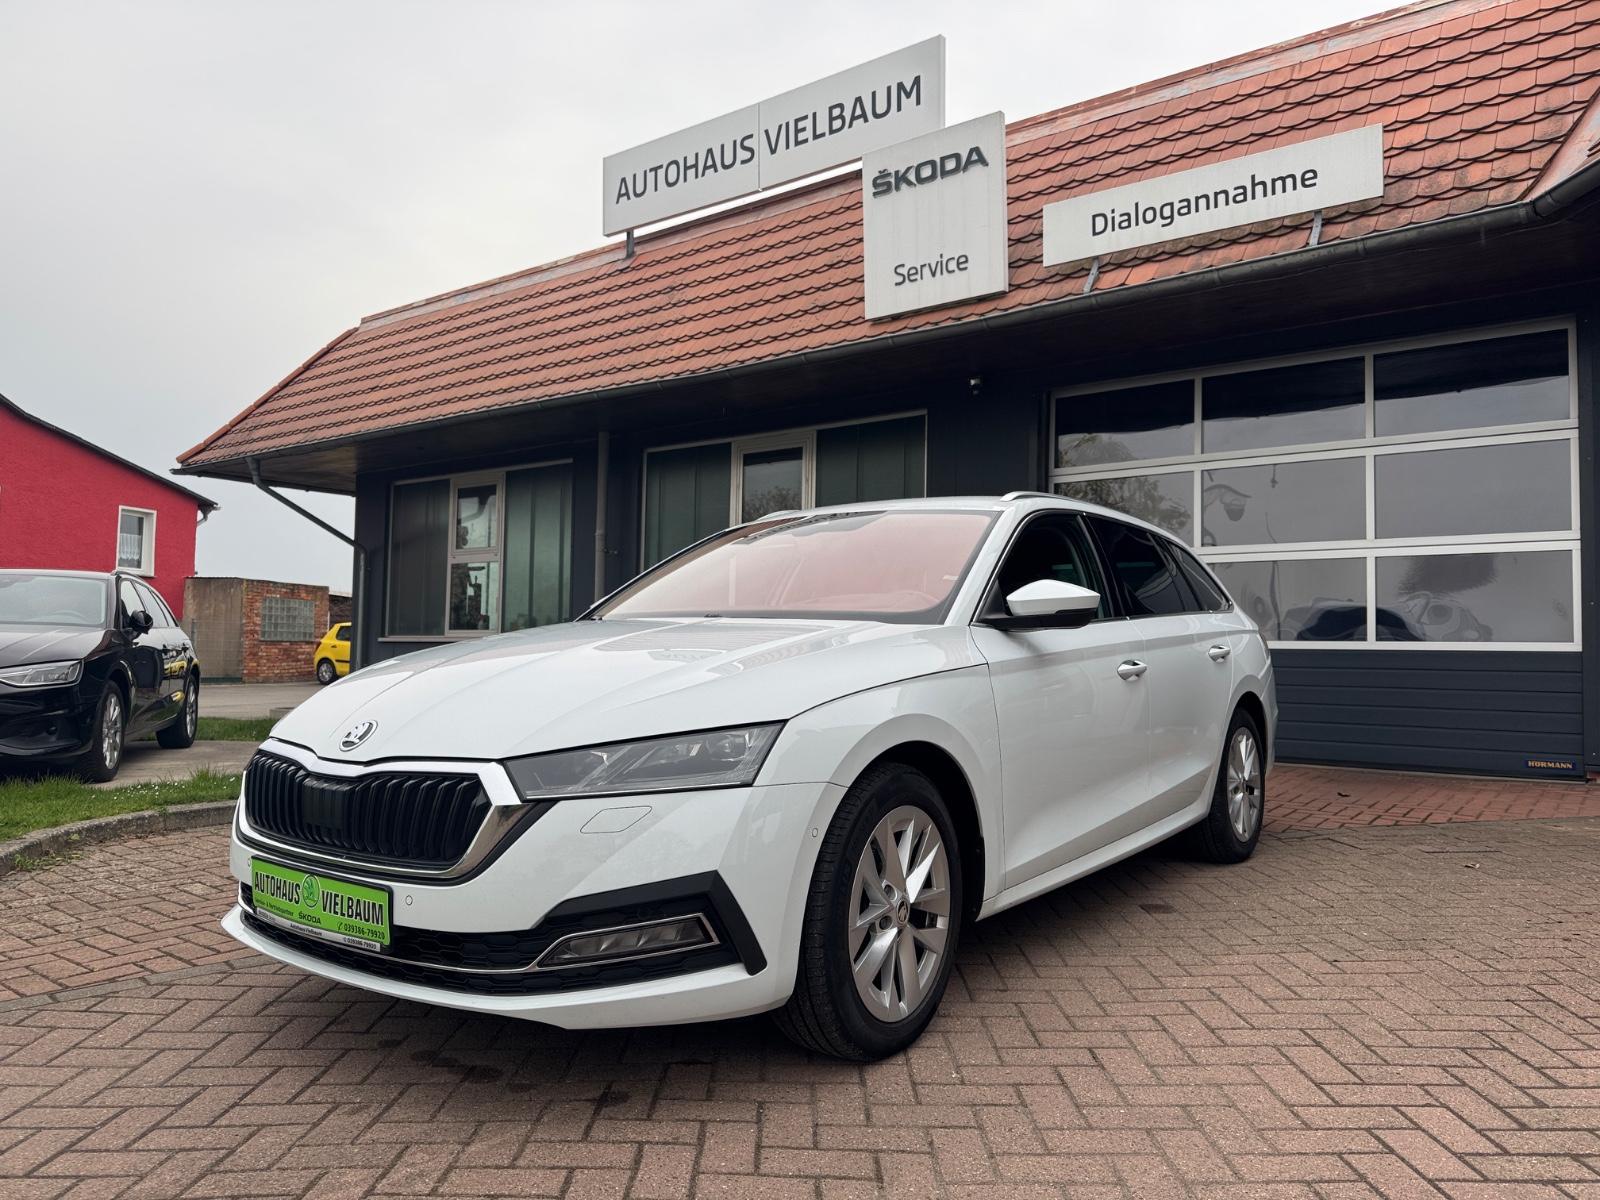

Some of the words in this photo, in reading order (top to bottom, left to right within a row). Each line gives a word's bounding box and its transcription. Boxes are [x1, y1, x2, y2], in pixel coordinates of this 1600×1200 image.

[615, 133, 756, 205] AUTOHAUS
[763, 74, 922, 156] VIELBAUM
[872, 145, 990, 198] ŠKODA
[1090, 167, 1319, 237] Dialogannahme
[893, 252, 969, 287] Service
[254, 871, 301, 905] AUTOHAUS
[321, 890, 385, 926] VIELBAUM
[298, 910, 321, 925] ŠKODA
